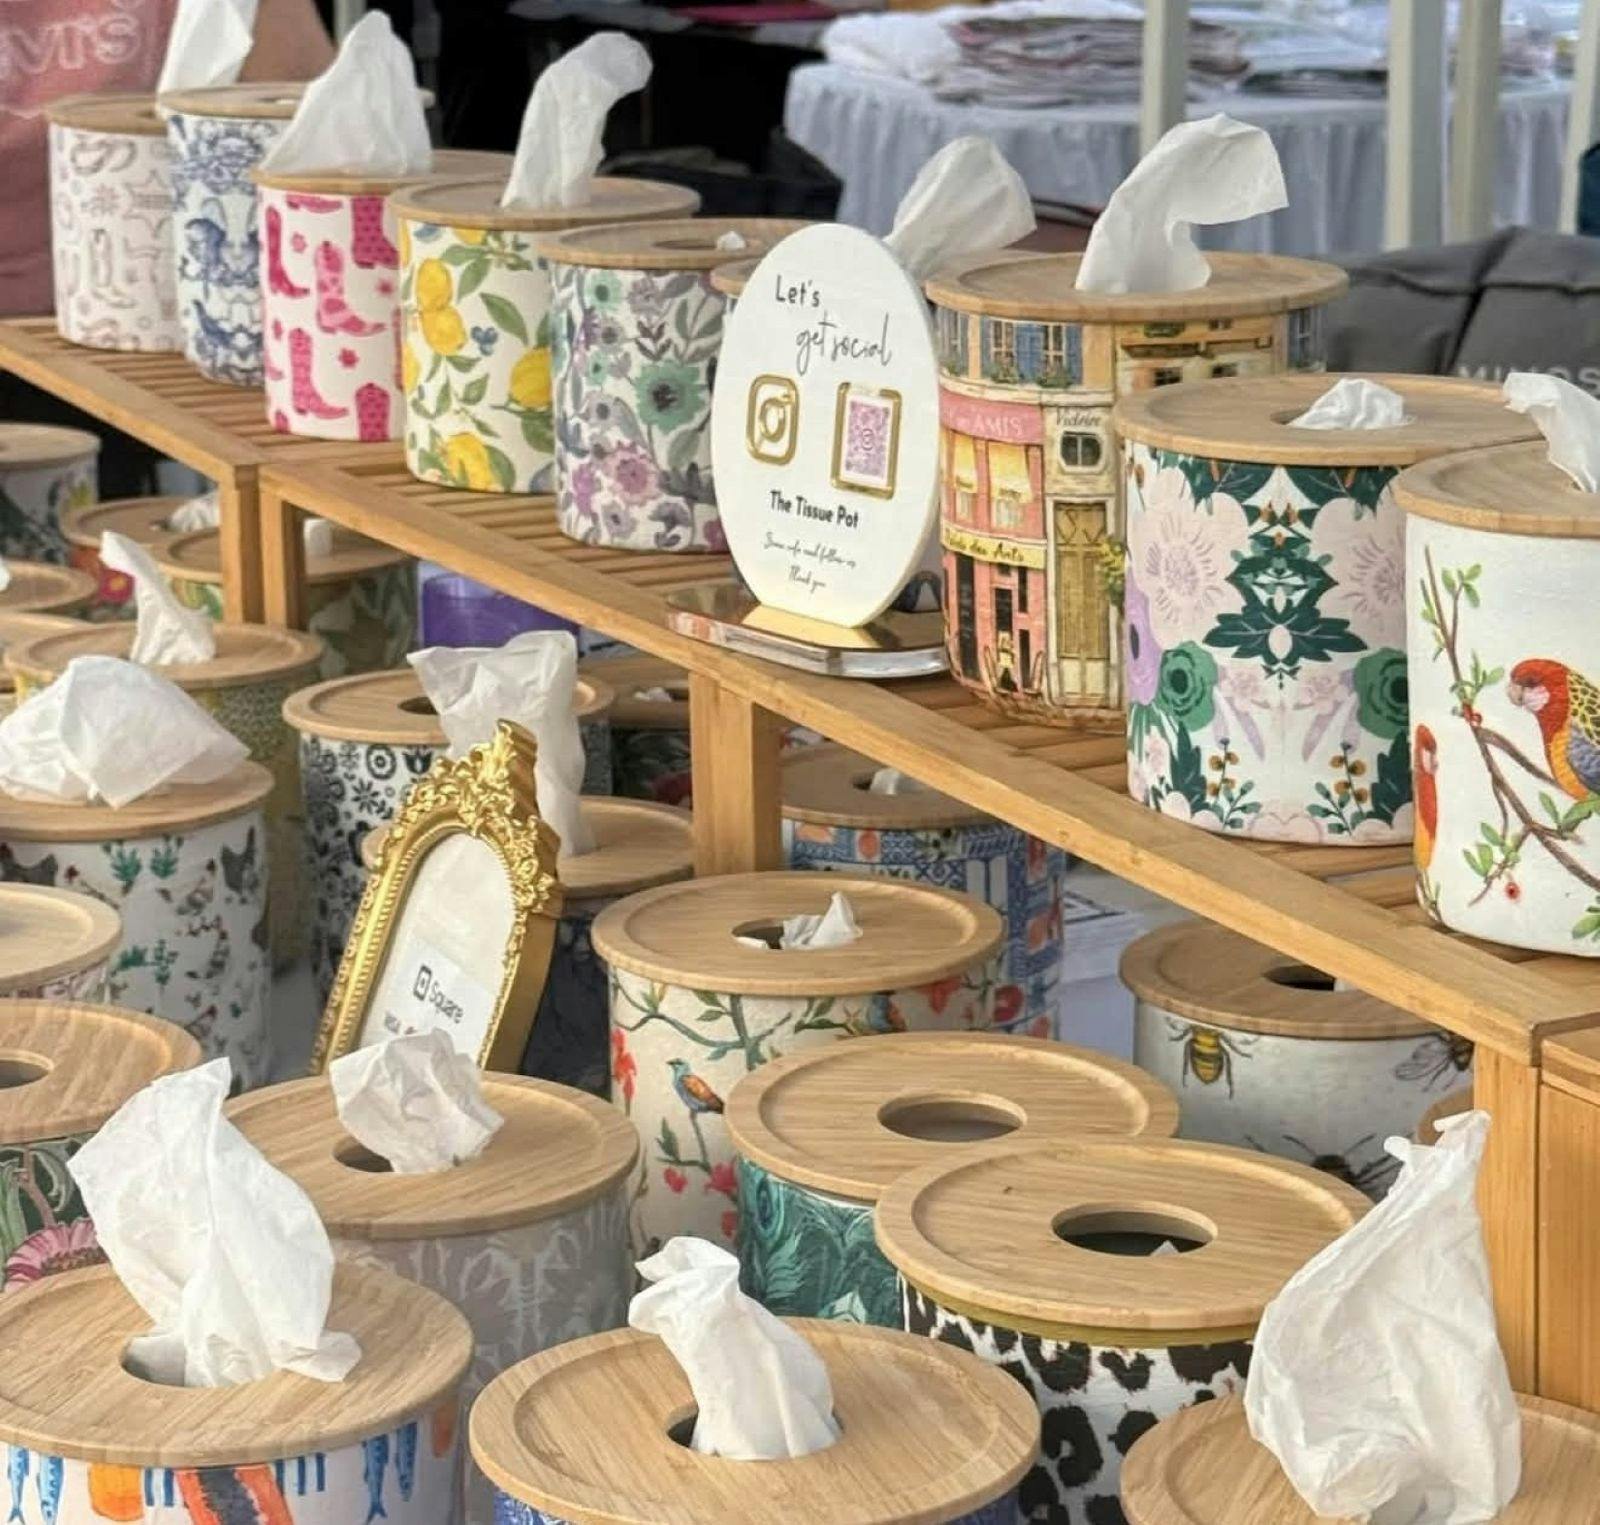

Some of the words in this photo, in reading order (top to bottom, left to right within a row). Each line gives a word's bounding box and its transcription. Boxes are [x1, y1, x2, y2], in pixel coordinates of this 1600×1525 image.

[776, 274, 820, 308] Let's
[796, 310, 838, 376] get
[831, 311, 893, 367] social
[770, 490, 792, 513] The
[795, 495, 834, 523] Tissue
[836, 504, 859, 529] Pot
[428, 981, 464, 1024] Square
